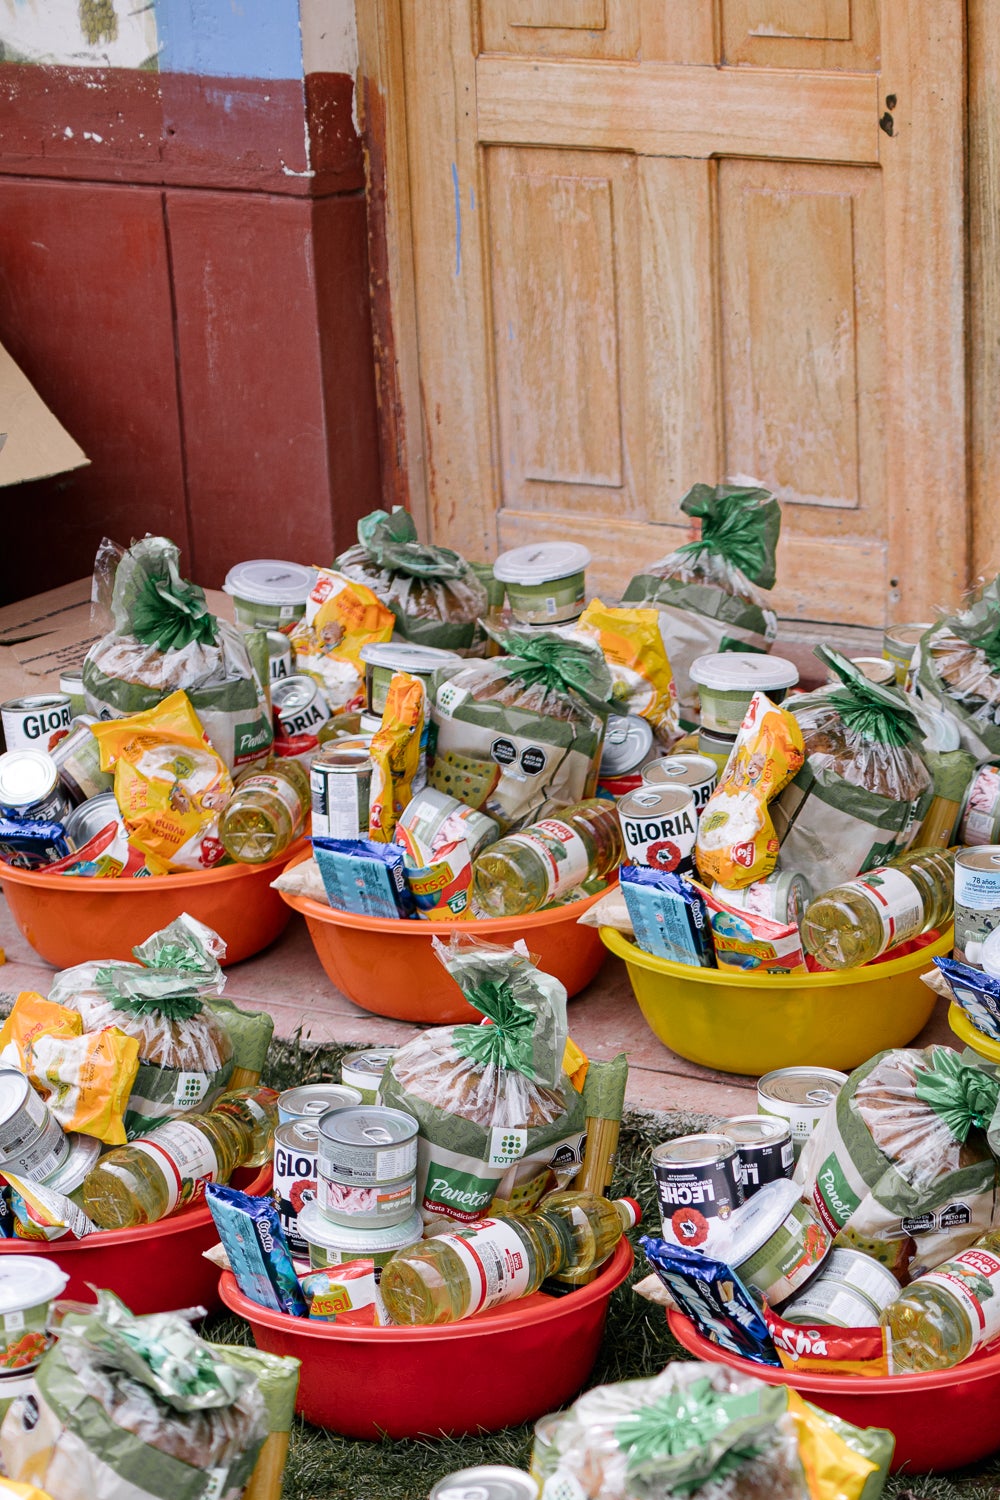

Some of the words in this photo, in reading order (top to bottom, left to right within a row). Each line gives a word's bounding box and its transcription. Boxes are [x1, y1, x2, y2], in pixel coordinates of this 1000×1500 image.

[152, 828, 181, 845] maca
[625, 811, 695, 847] GLORIA
[737, 847, 748, 858] 3
[972, 876, 981, 885] 78
[691, 899, 705, 929] Costa
[679, 1178, 713, 1188] EVAPORADA
[659, 1184, 715, 1205] LECHE
[425, 1201, 446, 1215] Receta
[257, 1220, 274, 1253] Costa
[962, 1253, 994, 1275] uno
[966, 1250, 998, 1271] PRECIO
[950, 1273, 973, 1297] Vegetal
